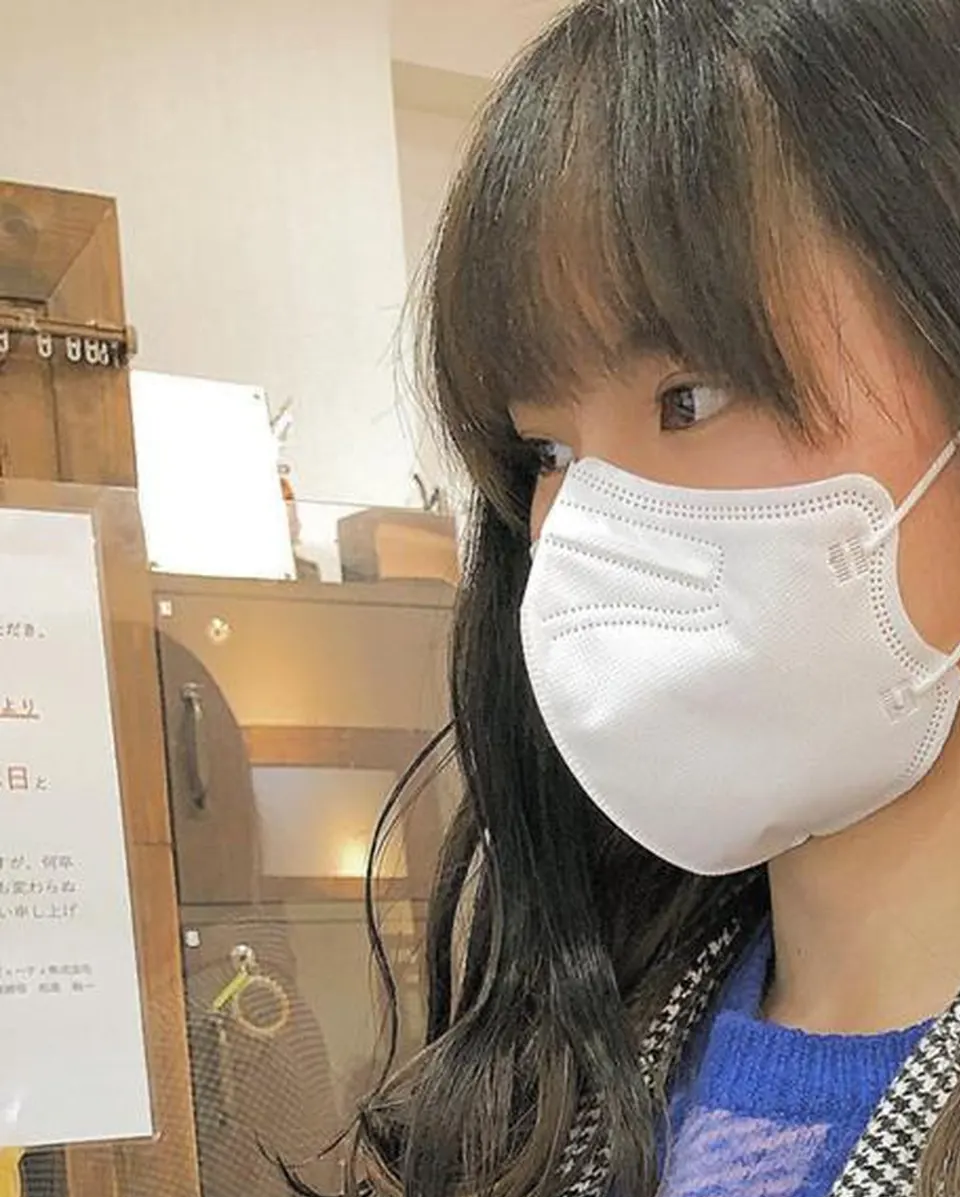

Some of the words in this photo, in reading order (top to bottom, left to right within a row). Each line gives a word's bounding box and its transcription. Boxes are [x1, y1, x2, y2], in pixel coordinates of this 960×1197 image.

[2, 697, 34, 715] より
[0, 855, 75, 871] が、何卒
